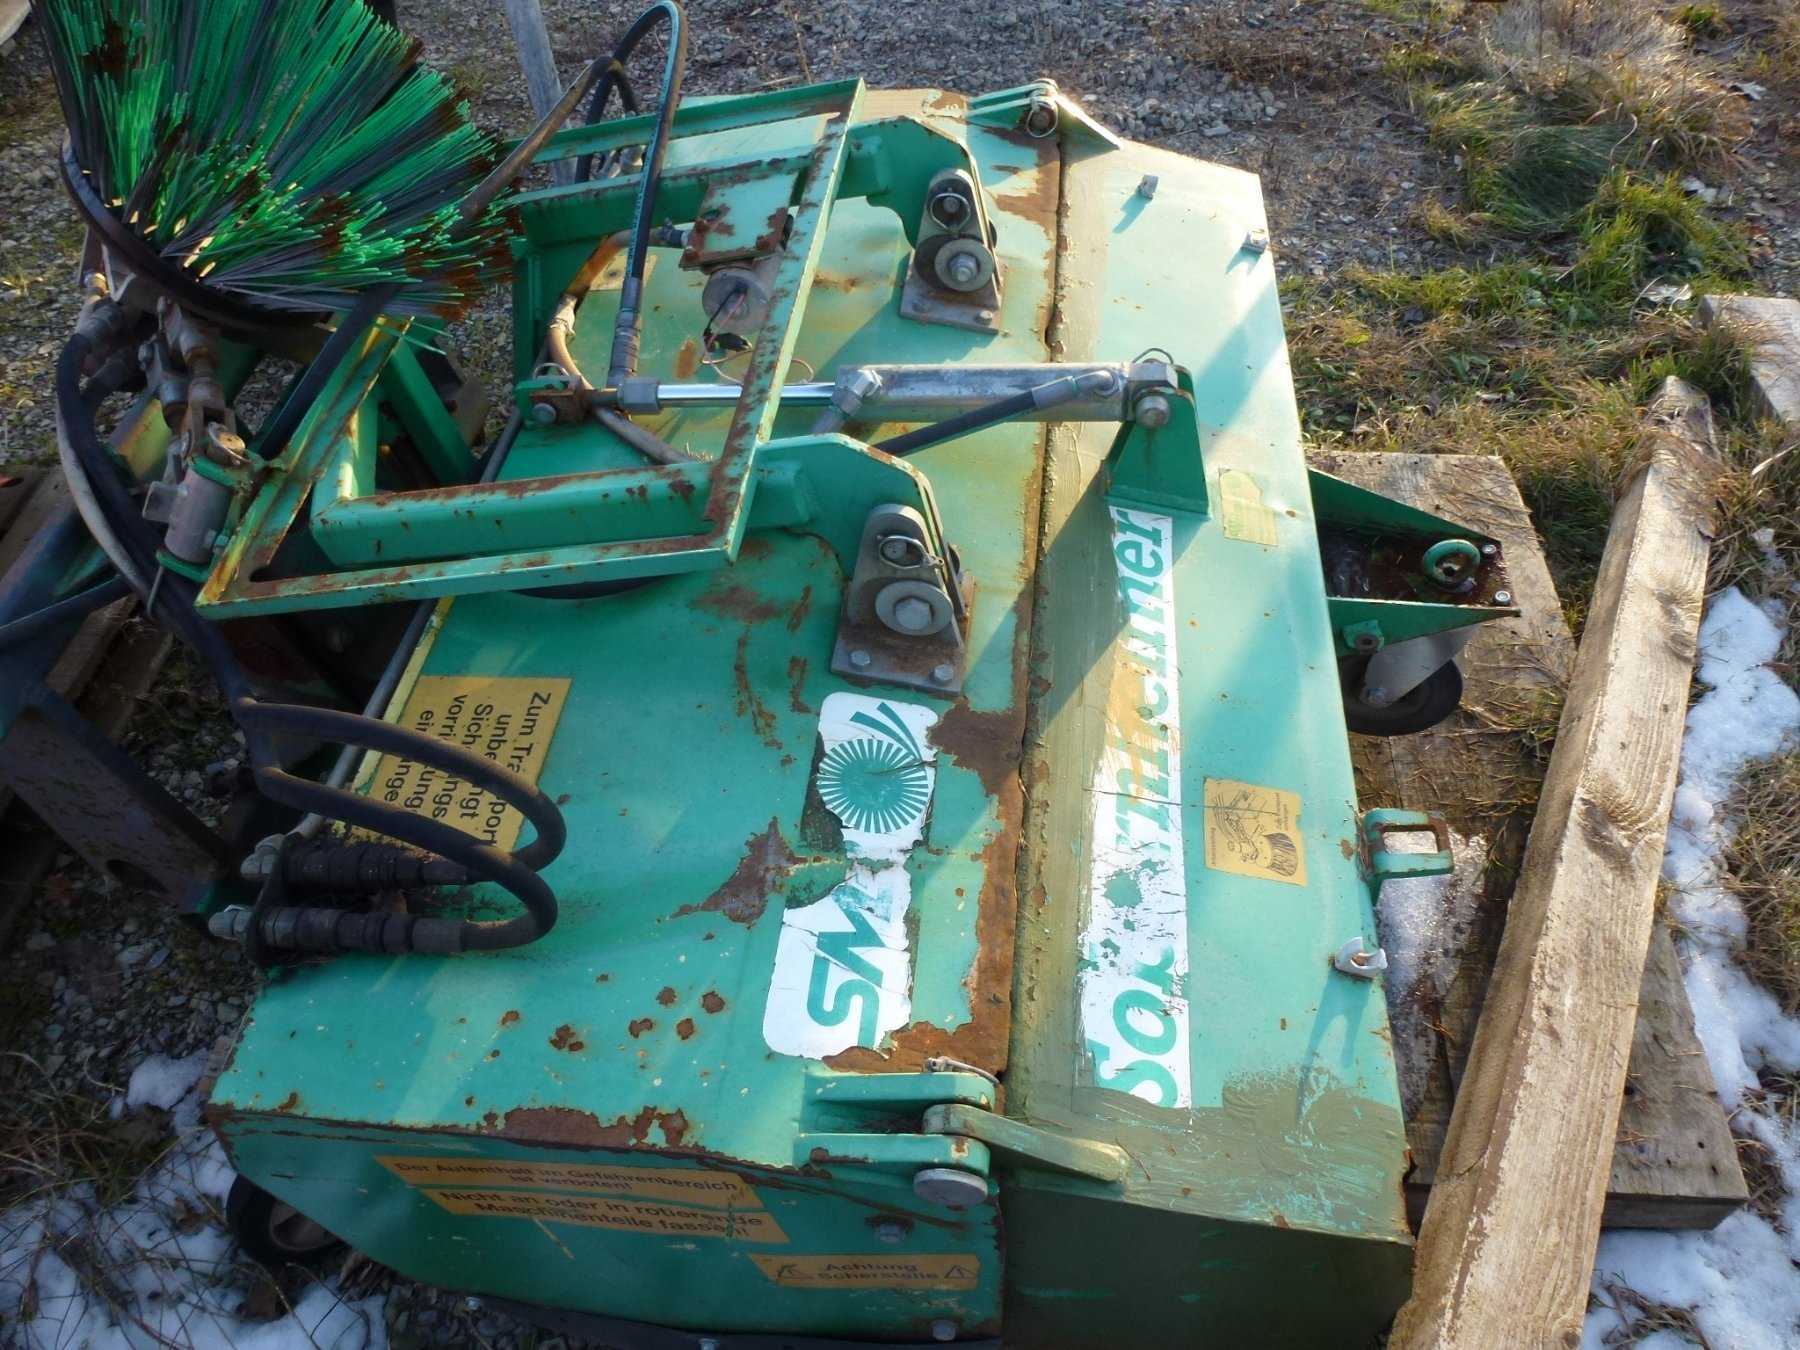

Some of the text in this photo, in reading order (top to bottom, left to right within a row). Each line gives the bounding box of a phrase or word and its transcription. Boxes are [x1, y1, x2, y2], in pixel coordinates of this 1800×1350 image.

[518, 691, 552, 736] Zum
[394, 1162, 430, 1173] Der
[439, 1191, 503, 1202] Nicht
[605, 1201, 630, 1213] in
[826, 1262, 919, 1273] Achtung
